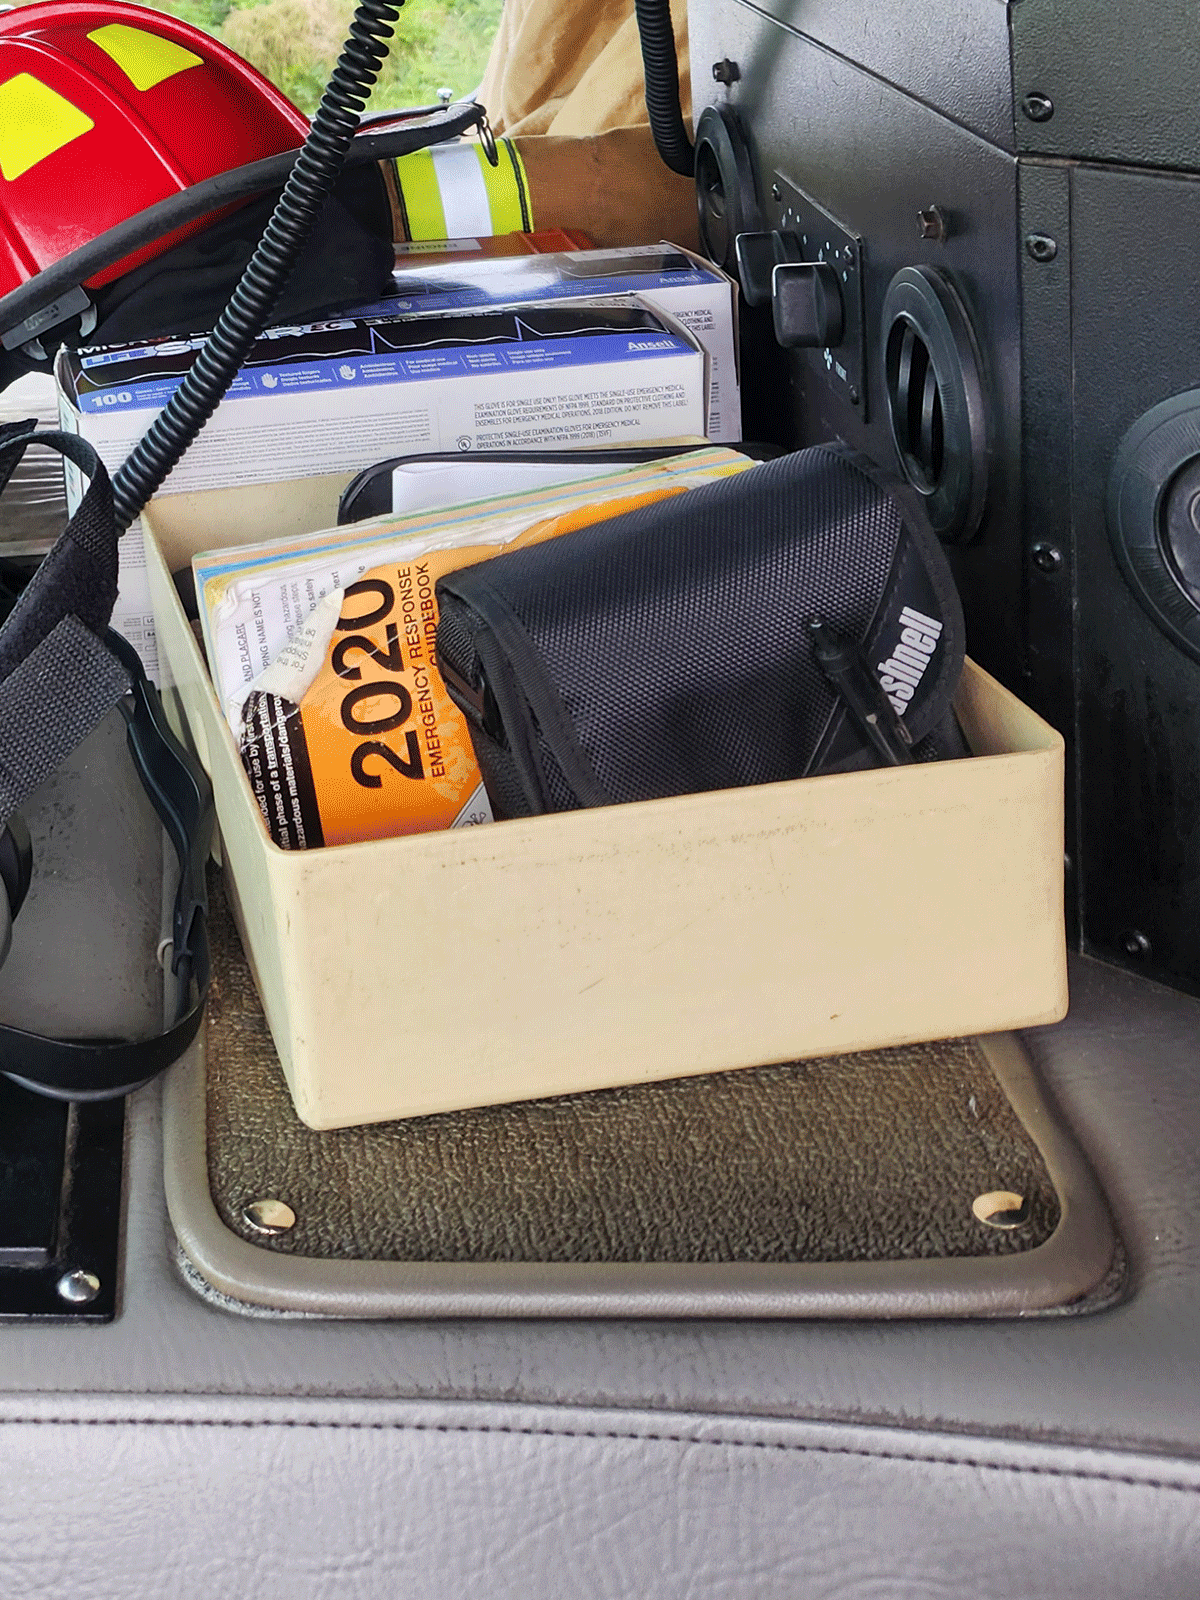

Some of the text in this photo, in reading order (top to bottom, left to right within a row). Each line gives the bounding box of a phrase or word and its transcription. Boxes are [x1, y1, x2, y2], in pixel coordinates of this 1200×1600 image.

[628, 340, 676, 351] Ansell
[92, 391, 133, 407] 100
[305, 578, 317, 601] safely
[252, 592, 262, 608] NOT
[255, 618, 267, 644] NAME
[877, 606, 943, 716] shnell
[243, 663, 253, 682] AND
[398, 566, 445, 778] EMERGENCY RESPONSE
[331, 578, 426, 789] 2020
[249, 743, 260, 758] by
[253, 758, 262, 778] use
[270, 769, 279, 779] a
[274, 694, 308, 850] azardous materials/dangerou
[255, 779, 265, 794] for
[270, 779, 281, 792] of
[274, 793, 289, 826] phase
